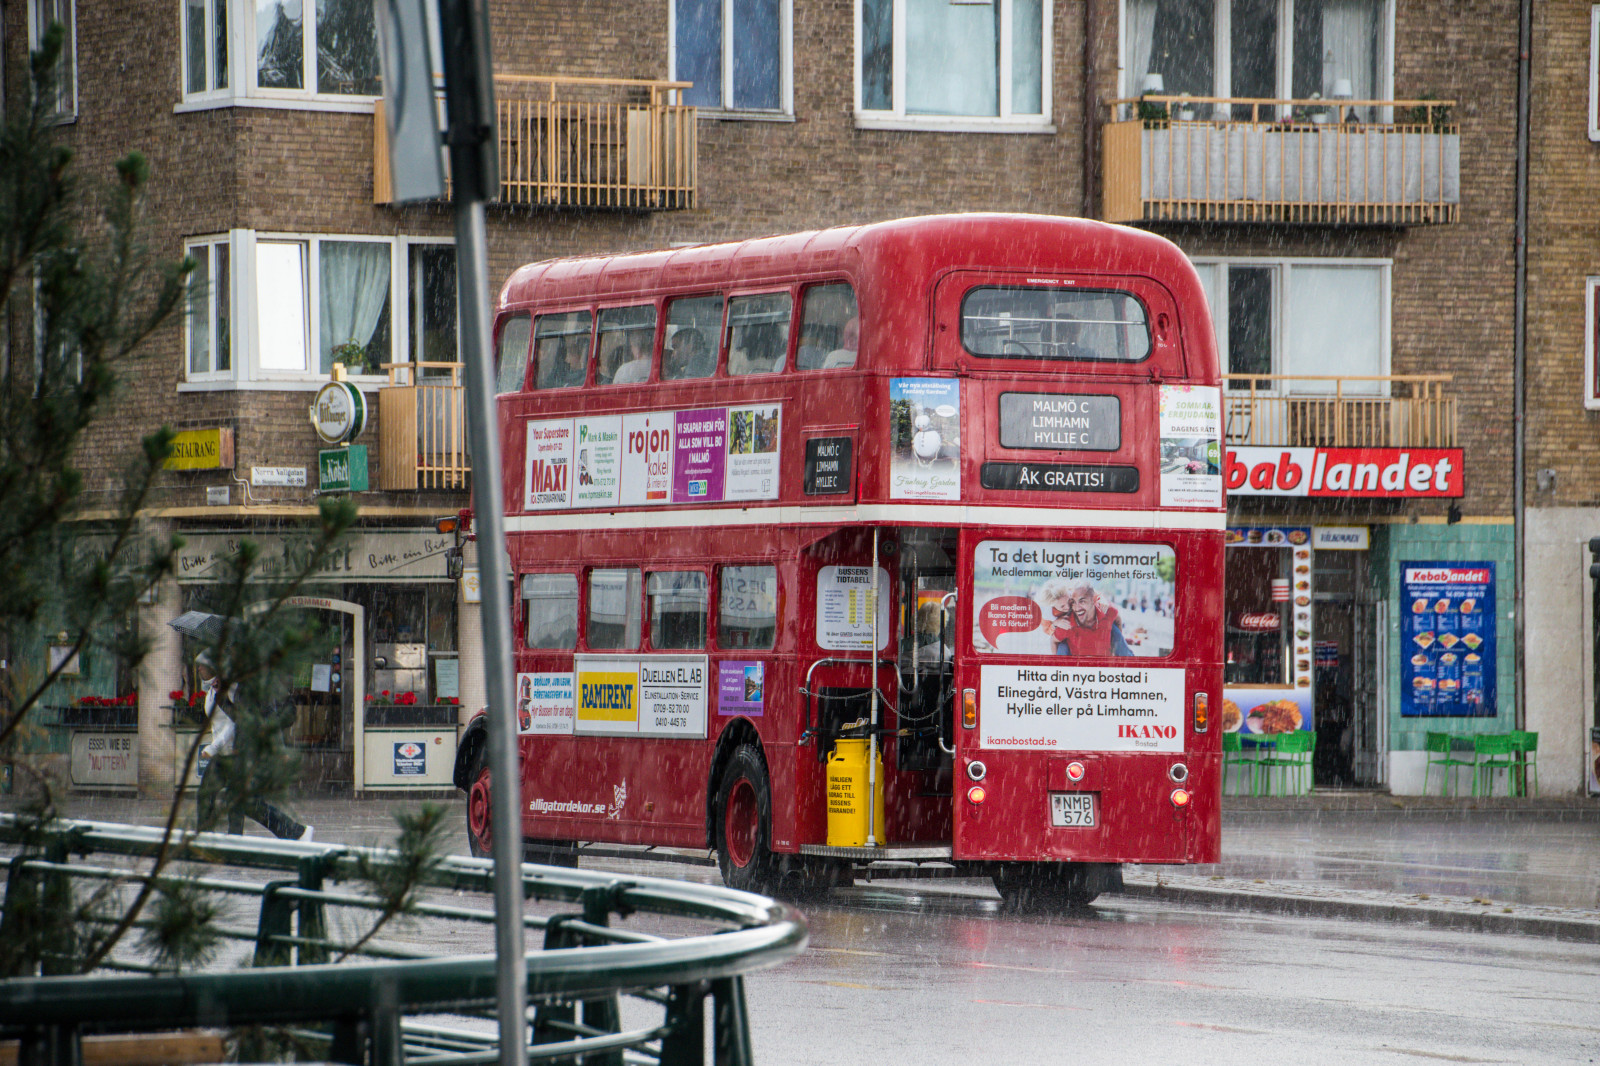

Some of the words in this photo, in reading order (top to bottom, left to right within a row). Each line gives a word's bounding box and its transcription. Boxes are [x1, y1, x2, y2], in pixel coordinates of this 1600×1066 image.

[1033, 399, 1077, 413] MALMÖ
[1080, 402, 1089, 413] C
[677, 423, 683, 434] VI
[683, 421, 702, 433] SKAPAR
[703, 420, 713, 432] HEM
[715, 418, 725, 431] FÖR
[1032, 416, 1090, 428] LIMHAMN
[532, 428, 544, 440] Your
[544, 426, 569, 441] Superstore
[580, 425, 588, 445] HP
[629, 418, 670, 463] rojon
[1034, 432, 1076, 444] HYLLIE
[1080, 433, 1088, 444] C
[679, 438, 690, 449] ALLA
[692, 437, 702, 448] SOM
[703, 437, 714, 447] VILL
[715, 436, 722, 447] BO
[818, 443, 835, 456] MALMÖ
[835, 445, 839, 456] C
[691, 450, 709, 463] MALMÖ
[648, 453, 668, 476] kakel
[817, 461, 838, 472] LIMHAMN
[1226, 452, 1302, 490] bab
[254, 468, 273, 476] Norra
[276, 468, 304, 477] Vallgatan
[531, 459, 567, 493] MAXI
[1020, 467, 1040, 485] ÅK
[1044, 472, 1104, 486] GRATIS!
[816, 477, 832, 487] HYLLIE
[833, 476, 837, 487] C
[895, 476, 928, 487] Fantasy
[930, 476, 956, 489] Garden
[368, 554, 397, 568] Bitte
[403, 550, 421, 560] ein
[424, 539, 448, 552] Bit
[990, 548, 1008, 563] Ta
[1012, 548, 1038, 563] det
[1042, 549, 1080, 567] lugnt
[1084, 550, 1089, 564] i
[1093, 551, 1161, 566] sommar!
[182, 556, 206, 571] Bitte
[992, 567, 1053, 577] Medlemmar
[1056, 569, 1083, 580] väljer
[1086, 569, 1130, 580] lägenhet
[1132, 570, 1158, 580] först.
[1413, 571, 1483, 581] Kebablandet
[1008, 611, 1033, 619] Förmån
[642, 668, 676, 683] DUELLEN
[678, 668, 688, 683] EL
[690, 668, 702, 683] AB
[1018, 670, 1047, 682] Hitta
[1050, 670, 1069, 682] din
[1072, 673, 1095, 684] nya
[1099, 671, 1141, 683] bostad
[1144, 672, 1148, 683] i
[582, 684, 633, 709] RAMIRENT
[998, 685, 1061, 701] Elinegård,
[1065, 687, 1107, 699] Västra
[1111, 688, 1167, 702] Hamnen,
[539, 705, 552, 716] Bussen
[1006, 703, 1042, 718] Hyllie
[1046, 704, 1072, 716] eller
[1077, 704, 1093, 718] på
[1097, 705, 1158, 717] Limhamn.
[1118, 724, 1177, 738] IKANO
[89, 738, 106, 750] ESSEN
[109, 738, 120, 750] WIE
[122, 739, 130, 750] BEI
[987, 736, 1057, 746] ikanobostad.se
[530, 798, 605, 814] alligatordekor.se
[1063, 797, 1091, 810] NMB
[1064, 811, 1092, 824] 576
